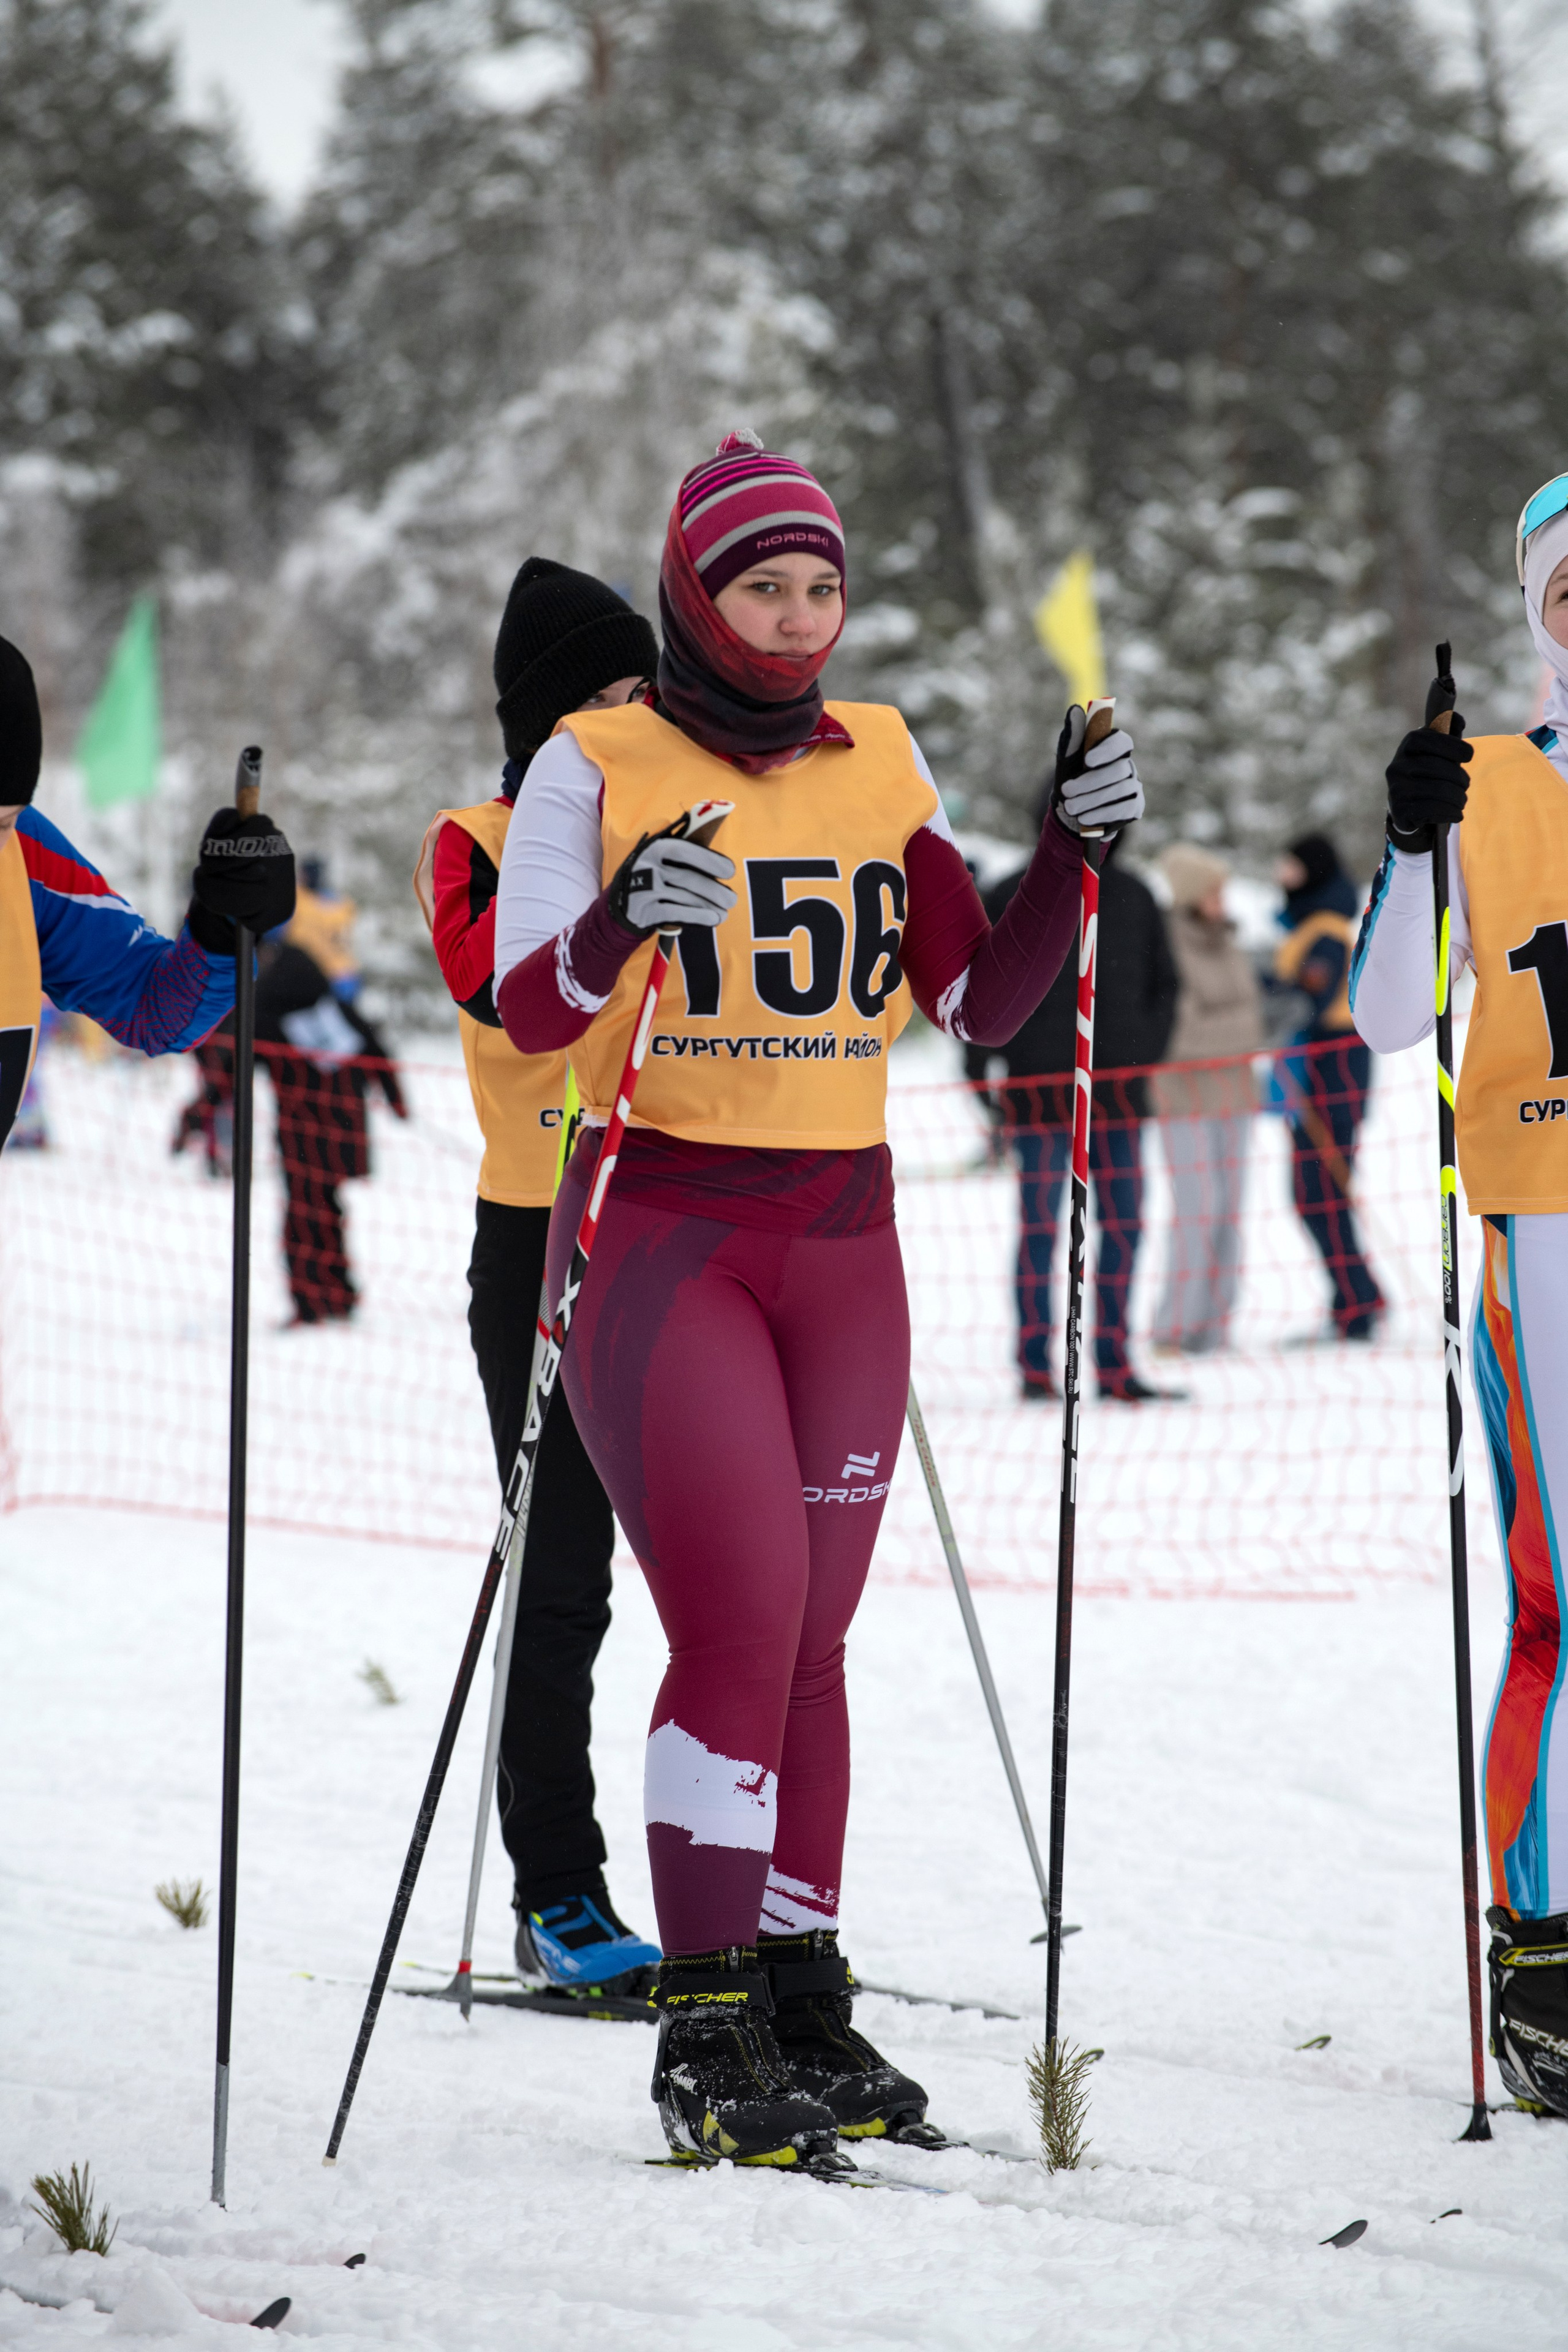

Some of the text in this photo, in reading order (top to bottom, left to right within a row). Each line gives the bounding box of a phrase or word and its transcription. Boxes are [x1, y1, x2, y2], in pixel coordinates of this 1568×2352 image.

[756, 532, 829, 550] NORDSKI
[651, 1031, 836, 1060] СУРГУТСКИЙ
[1519, 1098, 1568, 1124] СУР
